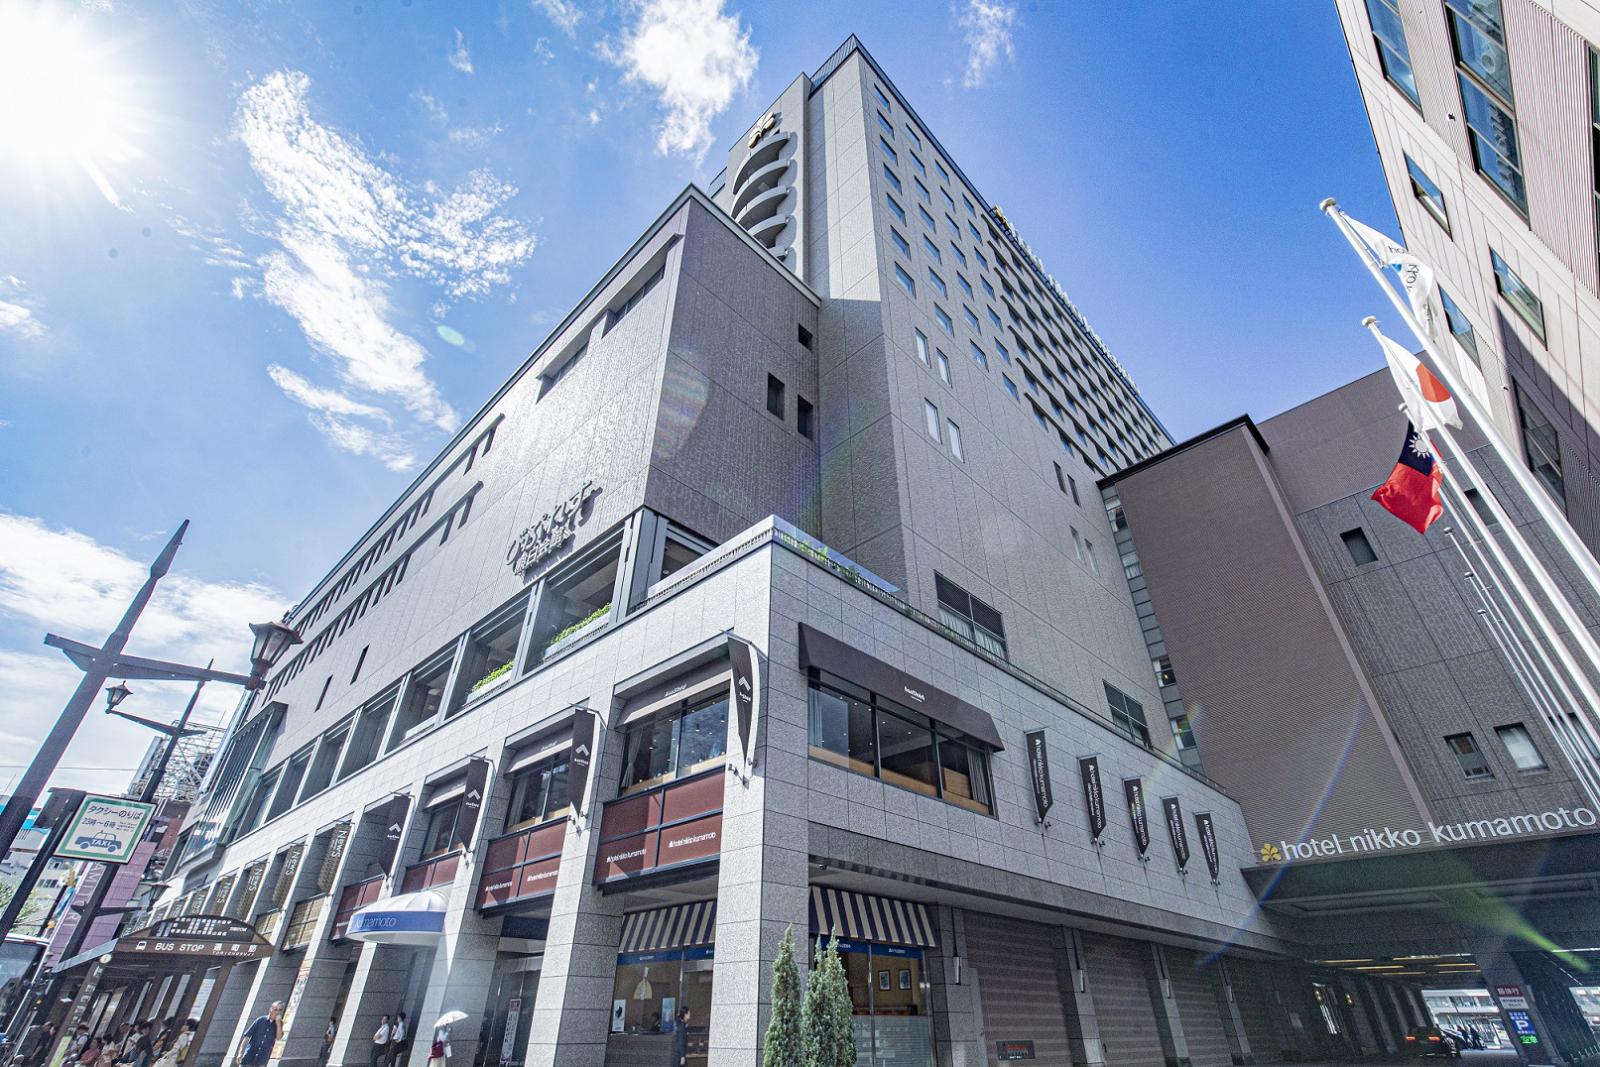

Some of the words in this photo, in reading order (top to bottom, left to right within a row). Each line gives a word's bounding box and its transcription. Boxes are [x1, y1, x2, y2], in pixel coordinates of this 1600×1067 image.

[1280, 835, 1343, 861] hotel
[1350, 827, 1420, 852] nikko
[1428, 806, 1597, 844] kumamoto
[91, 839, 110, 848] TAXI
[155, 943, 174, 951] BUS
[180, 944, 204, 952] STOP
[1515, 1021, 1529, 1030] P
